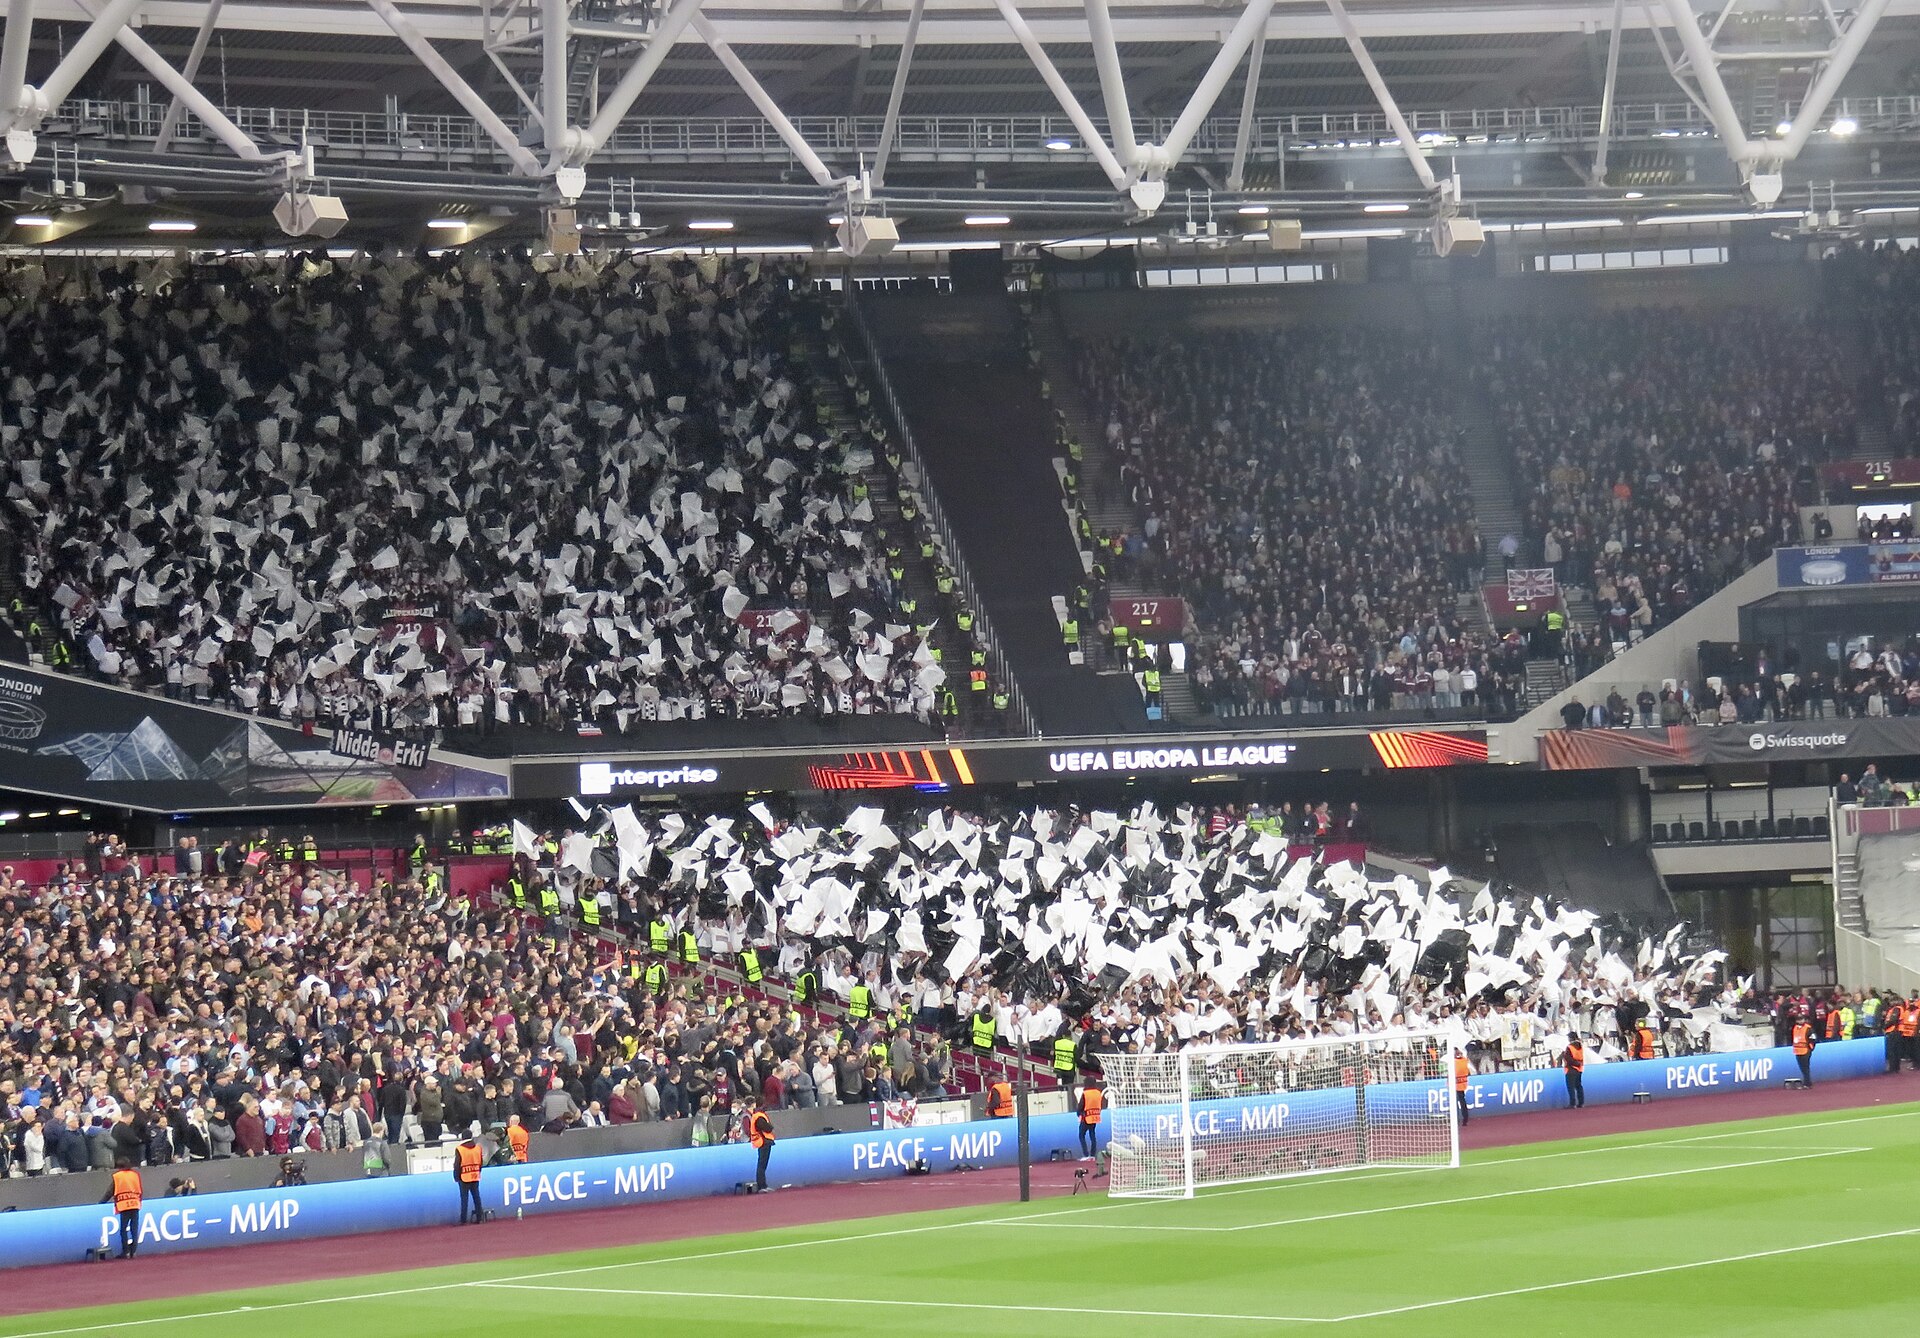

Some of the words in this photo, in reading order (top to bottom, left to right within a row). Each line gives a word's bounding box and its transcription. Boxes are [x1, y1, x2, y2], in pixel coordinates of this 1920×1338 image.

[1865, 461, 1892, 475] 215
[1804, 547, 1841, 556] LONDON
[756, 614, 775, 628] 21
[1132, 602, 1158, 616] 217
[0, 677, 43, 696] ONDON
[0, 688, 33, 701] TADIUM
[335, 729, 380, 759] Nidda
[392, 740, 426, 767] Erki
[1766, 732, 1847, 749] Swissquote
[1050, 752, 1109, 772] UEFA
[1112, 749, 1199, 770] EUROPA
[1202, 745, 1287, 767] LEAGUE
[1666, 1062, 1719, 1090] PEACE
[1734, 1057, 1773, 1083] МИР
[1427, 1084, 1485, 1113] PECE
[1502, 1078, 1544, 1105] МИР
[1242, 1103, 1290, 1131] МИР
[949, 1130, 1002, 1161] МИР
[503, 1170, 588, 1206] PEACE
[614, 1162, 675, 1195] МИР
[100, 1208, 199, 1247] PACE
[229, 1198, 300, 1235] МИР
